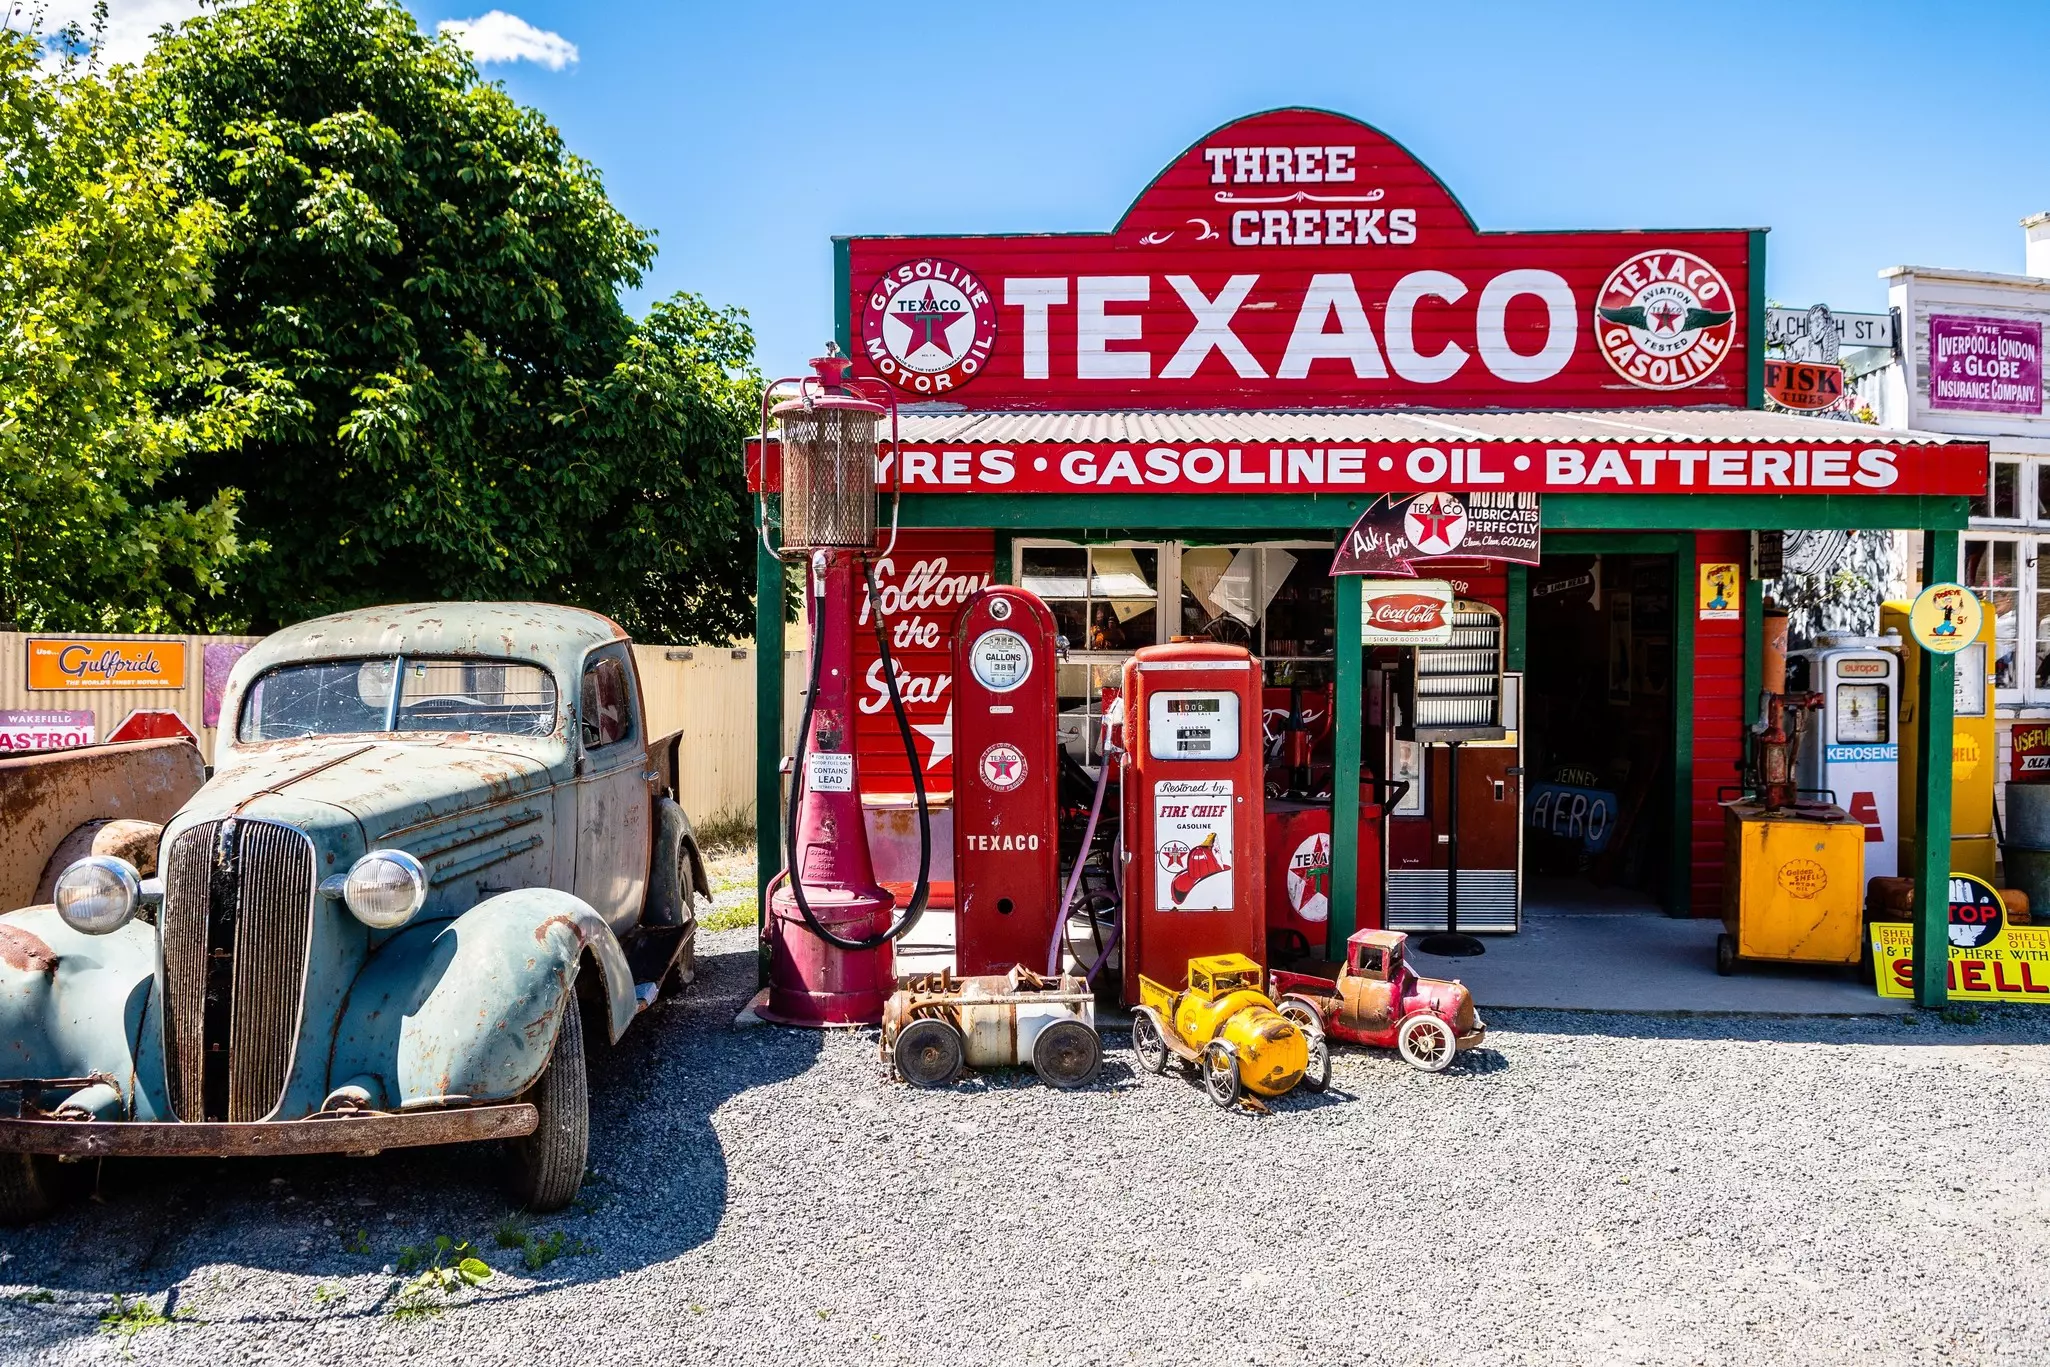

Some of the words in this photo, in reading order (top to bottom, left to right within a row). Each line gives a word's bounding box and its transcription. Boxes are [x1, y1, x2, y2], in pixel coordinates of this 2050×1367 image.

[1205, 146, 1356, 184] THREE
[1232, 209, 1417, 246] CREEKS
[1609, 256, 1720, 301] TEXACO
[871, 262, 989, 311] GASOLINE
[1643, 287, 1691, 305] AVIATION
[897, 300, 961, 312] TEXACO
[1004, 268, 1577, 384] TEXACO
[1855, 321, 1874, 339] ST
[1974, 325, 2000, 334] THE
[1644, 338, 1688, 352] TESTED
[1938, 333, 1990, 362] LIVERPOOL
[1991, 341, 1997, 355] &
[1998, 335, 2035, 362] LONDON
[1605, 328, 1725, 383] GASOLINE
[867, 337, 953, 392] MOTOR
[961, 335, 993, 374] OIL
[1952, 360, 1962, 374] &
[1965, 355, 2020, 379] GLOBE
[1765, 364, 1839, 394] FISK
[1937, 375, 1990, 399] INSURANCE
[1780, 392, 1824, 405] TIRES
[875, 450, 1016, 485] YRES
[1060, 448, 1366, 486] GASOLINE
[1406, 448, 1505, 485] OIL
[1546, 448, 1899, 488] BATTERIES
[1468, 492, 1515, 509] MOTOR
[1517, 492, 1539, 510] OIL
[1413, 503, 1463, 515] TEXACO
[1468, 508, 1538, 522] LUBRICATES
[1467, 521, 1539, 534] PERFECTLY
[1353, 526, 1382, 559] Ask
[1385, 532, 1408, 558] for
[1501, 536, 1538, 550] GOLDEN
[1376, 604, 1439, 623] Coca-Cola
[893, 616, 941, 649] the
[59, 644, 161, 678] Gulfpride
[986, 653, 1021, 661] GALLONS
[1844, 663, 1879, 674] europa
[8, 715, 73, 723] WAKEFIELD
[1827, 747, 1898, 760] KEROSENE
[1952, 747, 1977, 762] HELL
[813, 767, 848, 775] CONTAINS
[1555, 768, 1599, 787] JENNEY
[818, 775, 843, 783] LEAD
[1160, 782, 1208, 793] Restored
[1211, 782, 1228, 795] by
[1160, 805, 1189, 818] FIRE
[1191, 805, 1227, 818] CHIEF
[1532, 791, 1607, 841] AERO
[966, 835, 1039, 851] TEXACO
[1295, 852, 1328, 867] TEXA
[1786, 869, 1813, 877] Golden
[1795, 874, 1820, 882] SHELL
[1949, 905, 1997, 923] TOP
[1883, 929, 1913, 939] SHEL
[2007, 932, 2046, 941] SHELL
[1886, 946, 1898, 957] &
[2009, 940, 2046, 949] OILS
[1965, 949, 2004, 960] HERE
[2010, 950, 2049, 961] WITH
